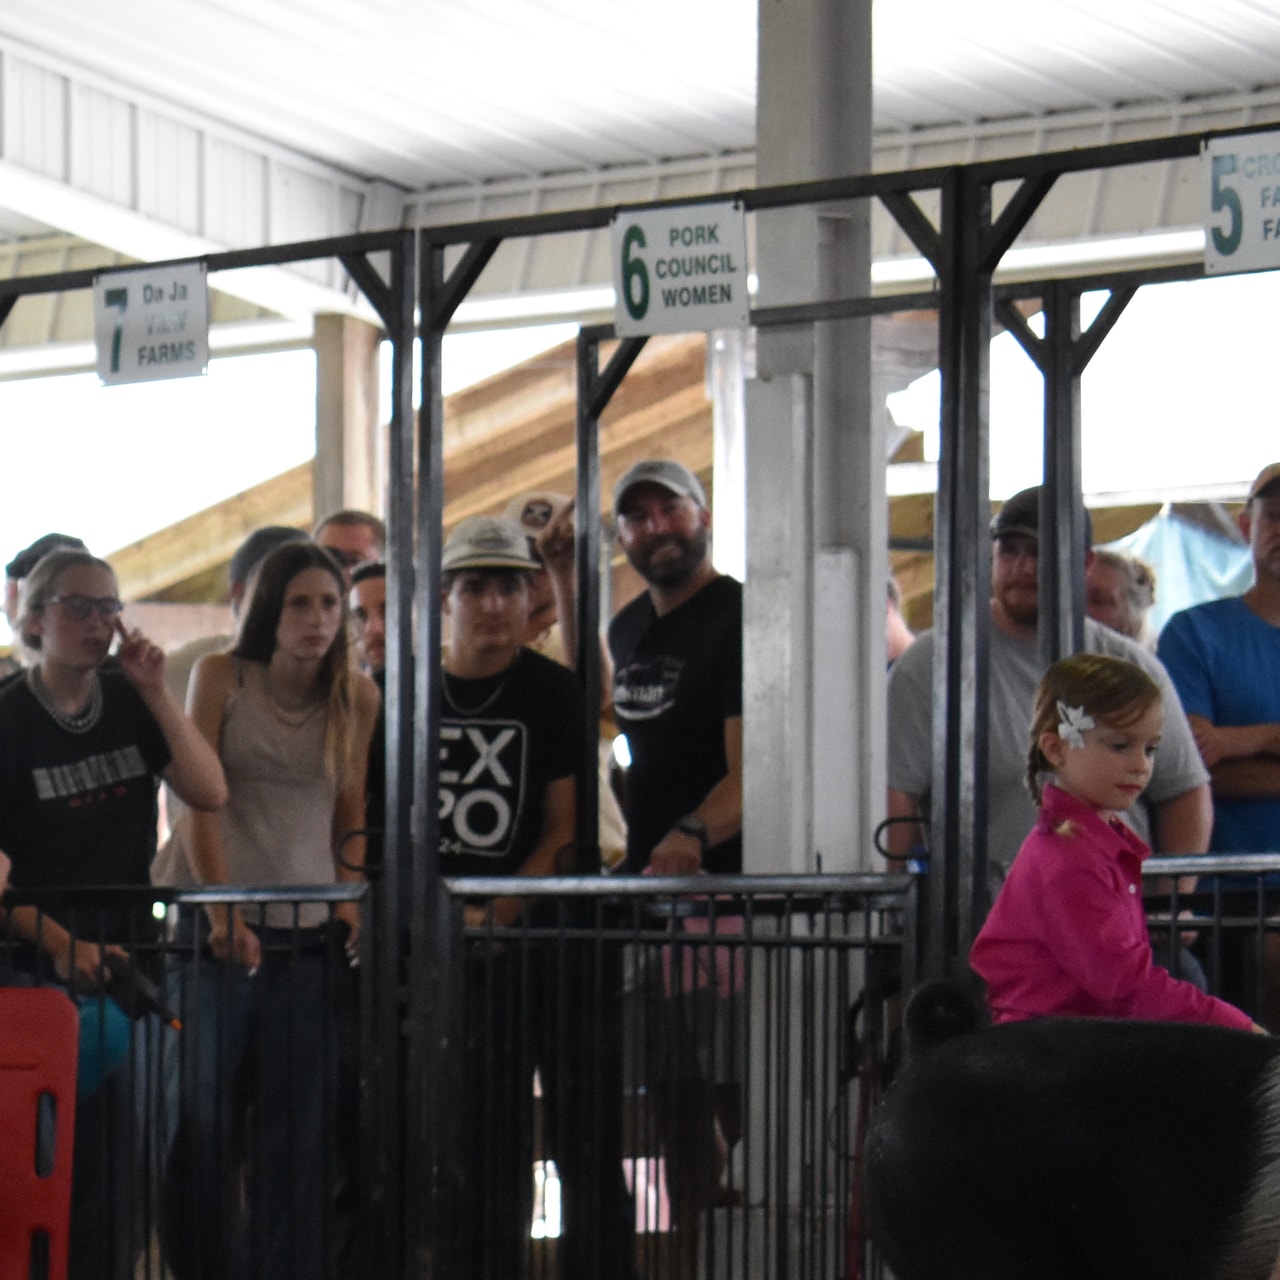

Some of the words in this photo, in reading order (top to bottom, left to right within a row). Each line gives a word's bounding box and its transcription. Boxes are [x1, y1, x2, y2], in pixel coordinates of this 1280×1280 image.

[1211, 154, 1243, 257] 5
[669, 223, 719, 247] PORK
[622, 224, 650, 321] 6
[655, 253, 737, 279] COUNCIL
[662, 283, 732, 308] WOMEN
[104, 287, 128, 373] 7
[137, 340, 195, 366] FARMS
